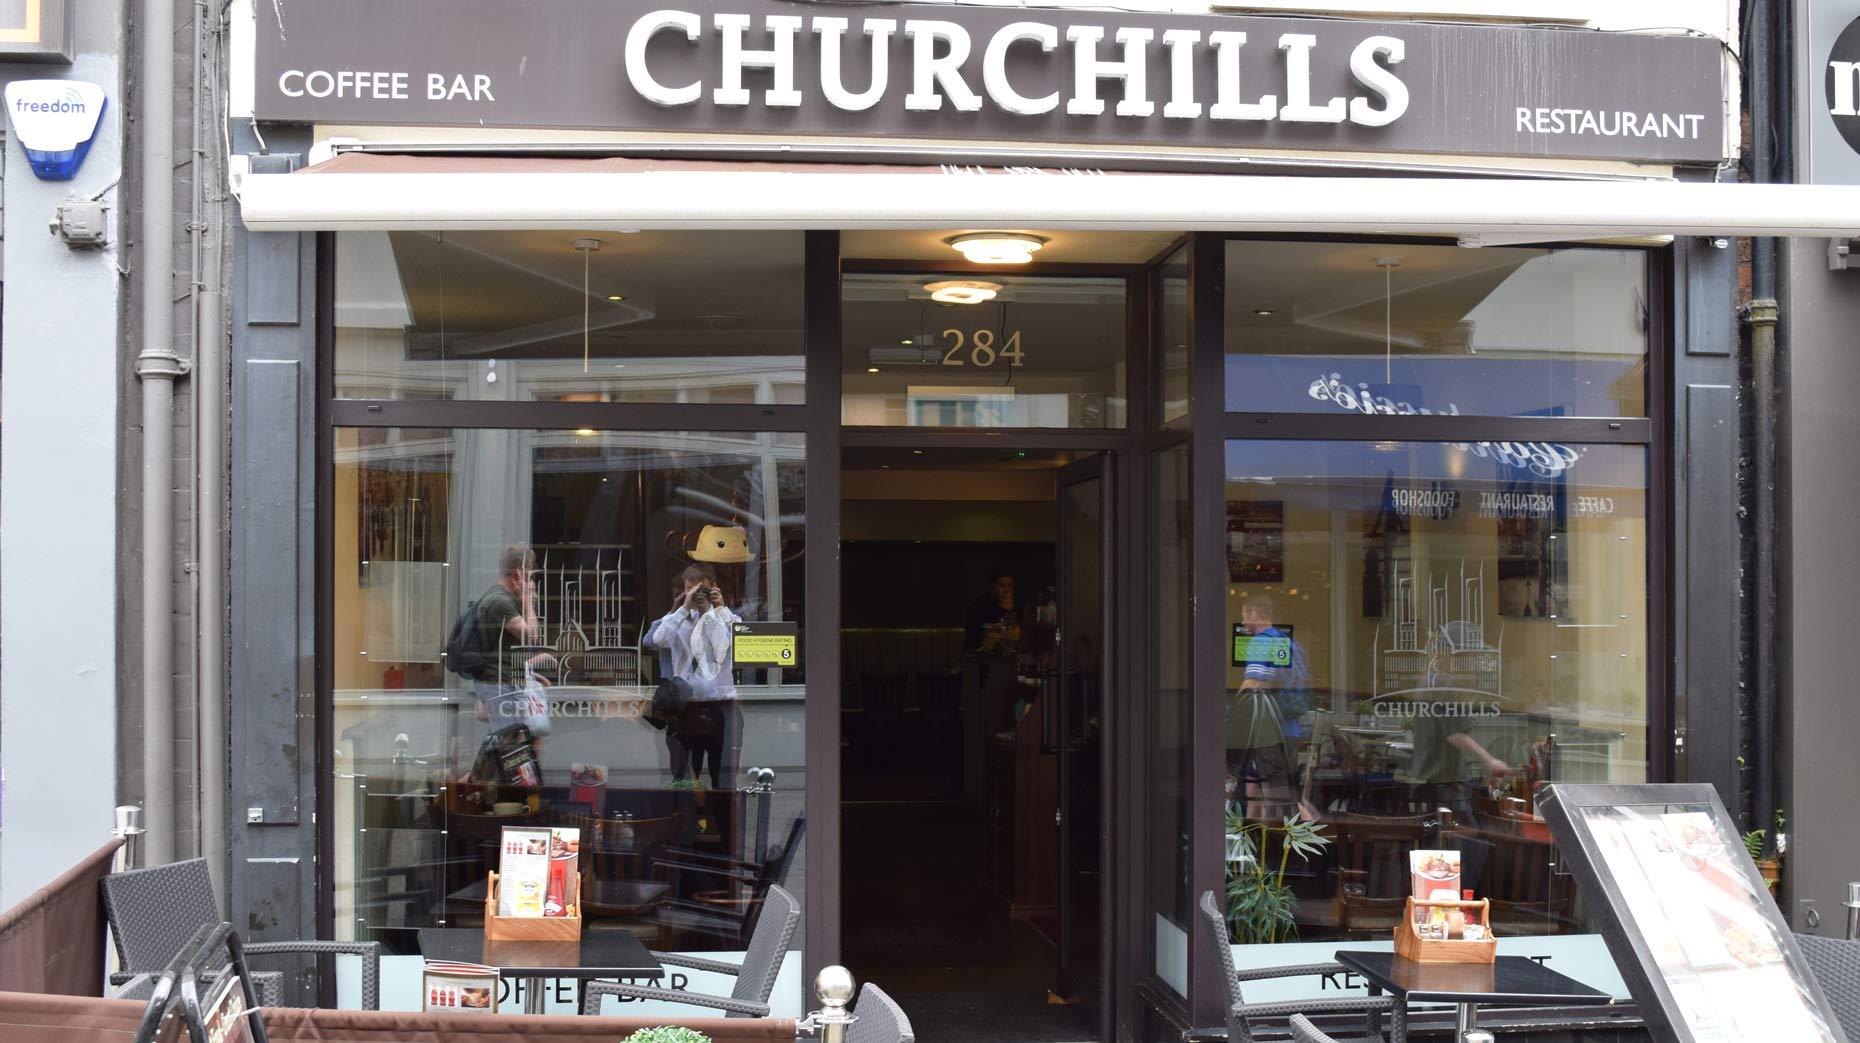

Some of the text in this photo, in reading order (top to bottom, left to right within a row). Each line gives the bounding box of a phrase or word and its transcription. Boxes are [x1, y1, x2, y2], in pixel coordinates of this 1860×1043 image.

[624, 9, 1409, 128] CHURCHILLS
[279, 70, 495, 102] COFFEE BAR
[16, 98, 86, 114] freedom
[1515, 107, 1705, 139] RESTAURANT
[942, 328, 1026, 367] 284
[783, 649, 790, 659] 5
[499, 700, 641, 718] CHRCHILLS
[1374, 700, 1500, 718] CHURCHILLS
